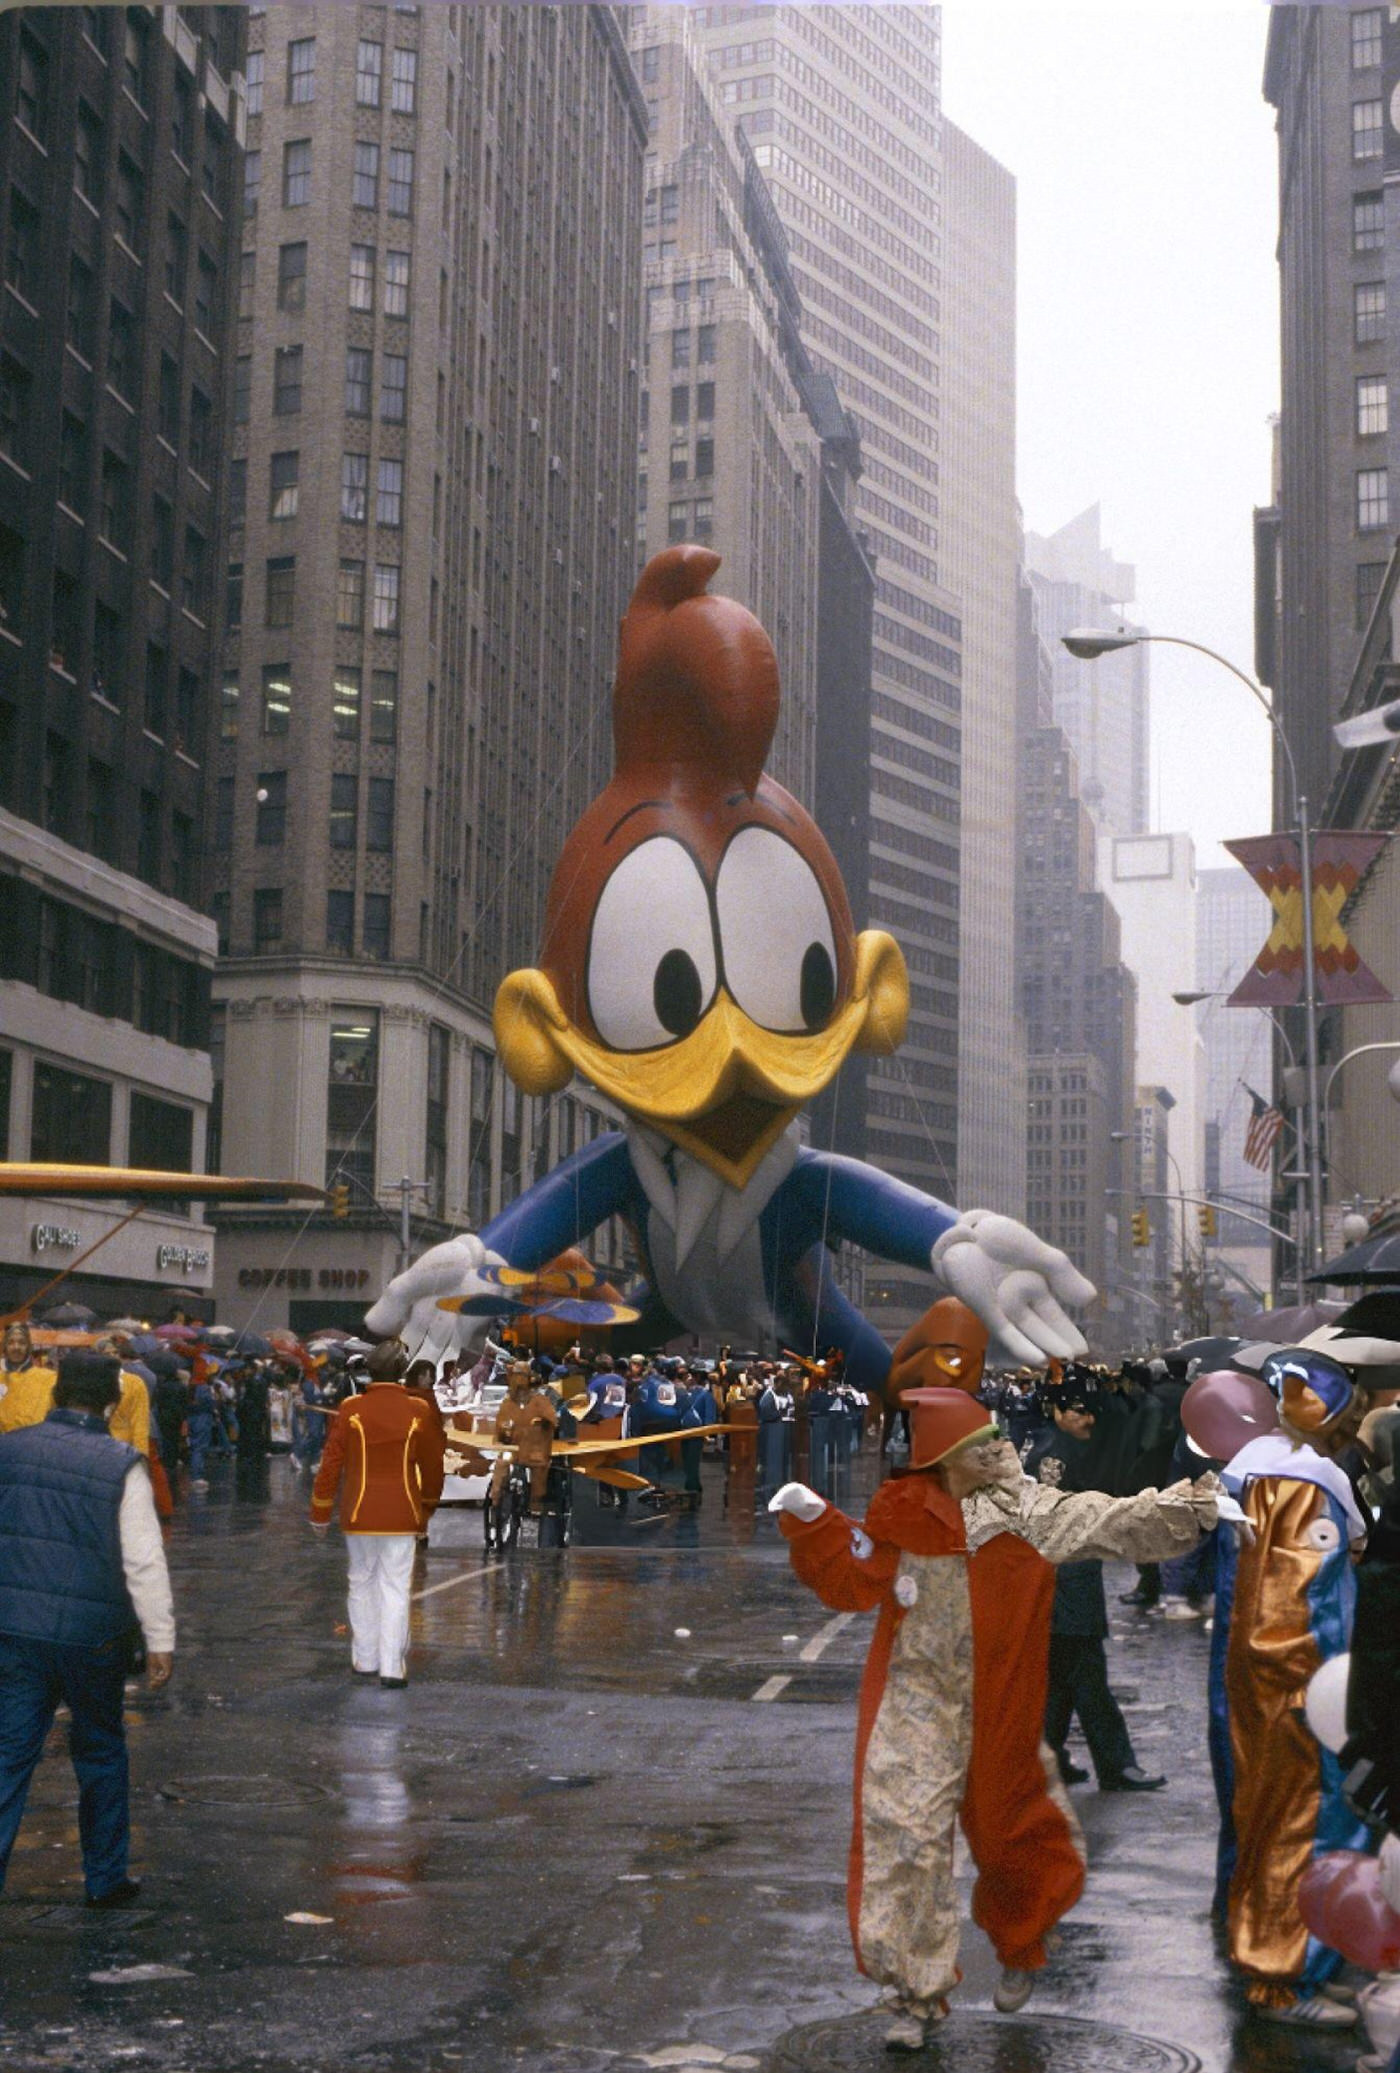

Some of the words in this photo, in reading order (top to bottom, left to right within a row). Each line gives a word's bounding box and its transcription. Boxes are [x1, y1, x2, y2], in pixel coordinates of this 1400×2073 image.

[58, 1228, 81, 1246] SHOES
[239, 1268, 312, 1288] COFFEE
[318, 1268, 370, 1288] SHOP
